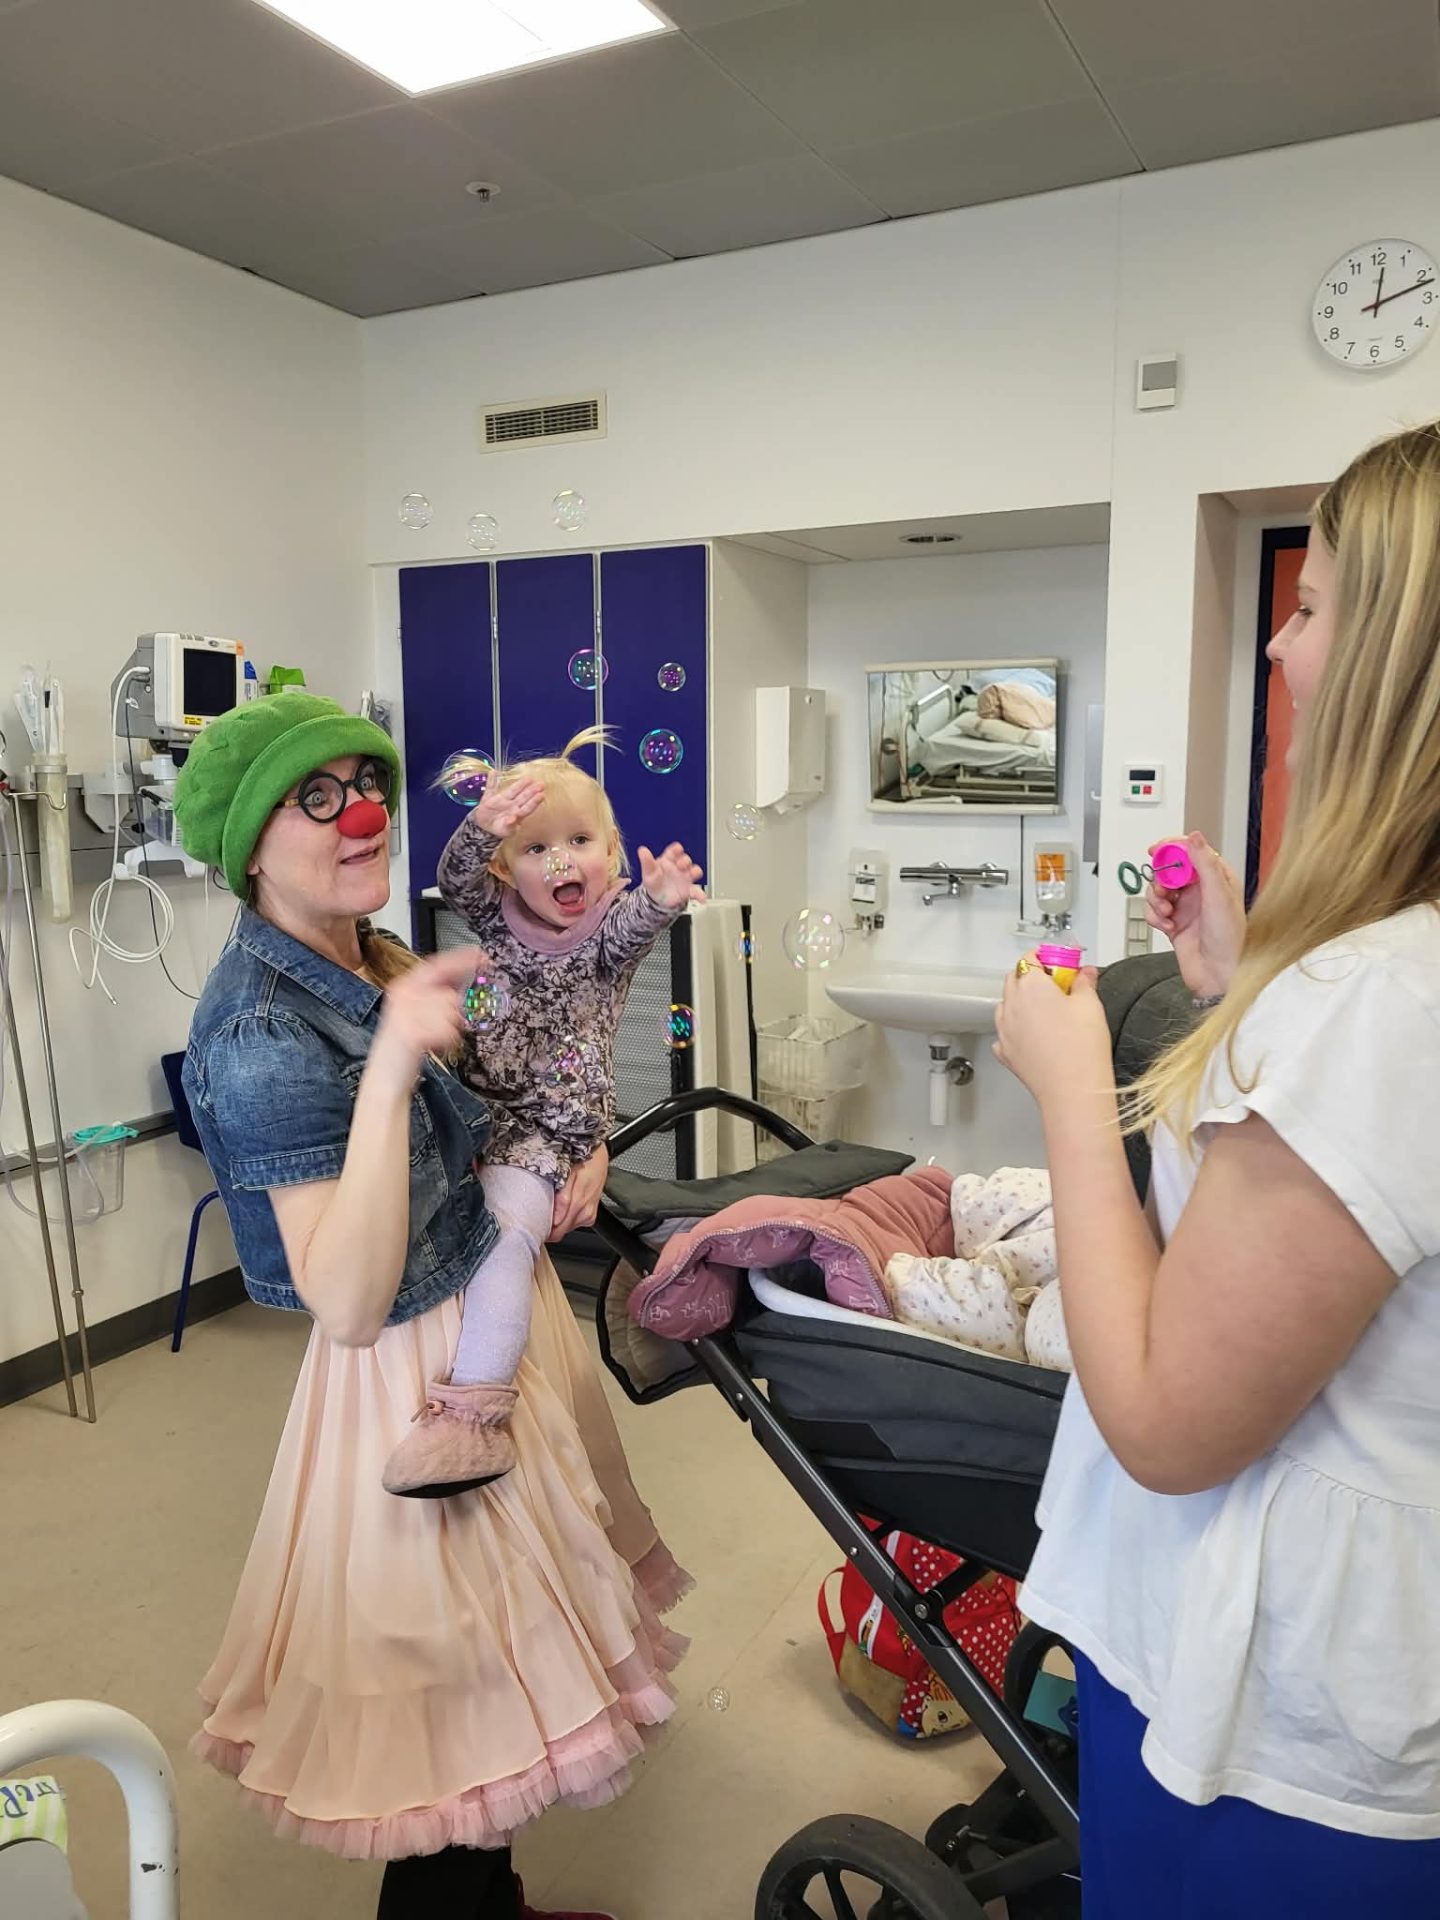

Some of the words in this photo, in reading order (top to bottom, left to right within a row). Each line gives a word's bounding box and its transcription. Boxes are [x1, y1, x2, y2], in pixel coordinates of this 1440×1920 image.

[1370, 252, 1387, 266] 12
[1400, 255, 1406, 268] 1
[1349, 262, 1362, 276] 11
[1416, 269, 1427, 283] 2
[1331, 281, 1348, 295] 10
[1422, 291, 1433, 305] 3
[1323, 306, 1334, 319] 9
[1413, 316, 1424, 328] 4
[1329, 327, 1340, 340] 8
[1346, 341, 1356, 355] 7
[1394, 335, 1404, 348] 5
[1369, 345, 1380, 358] 6
